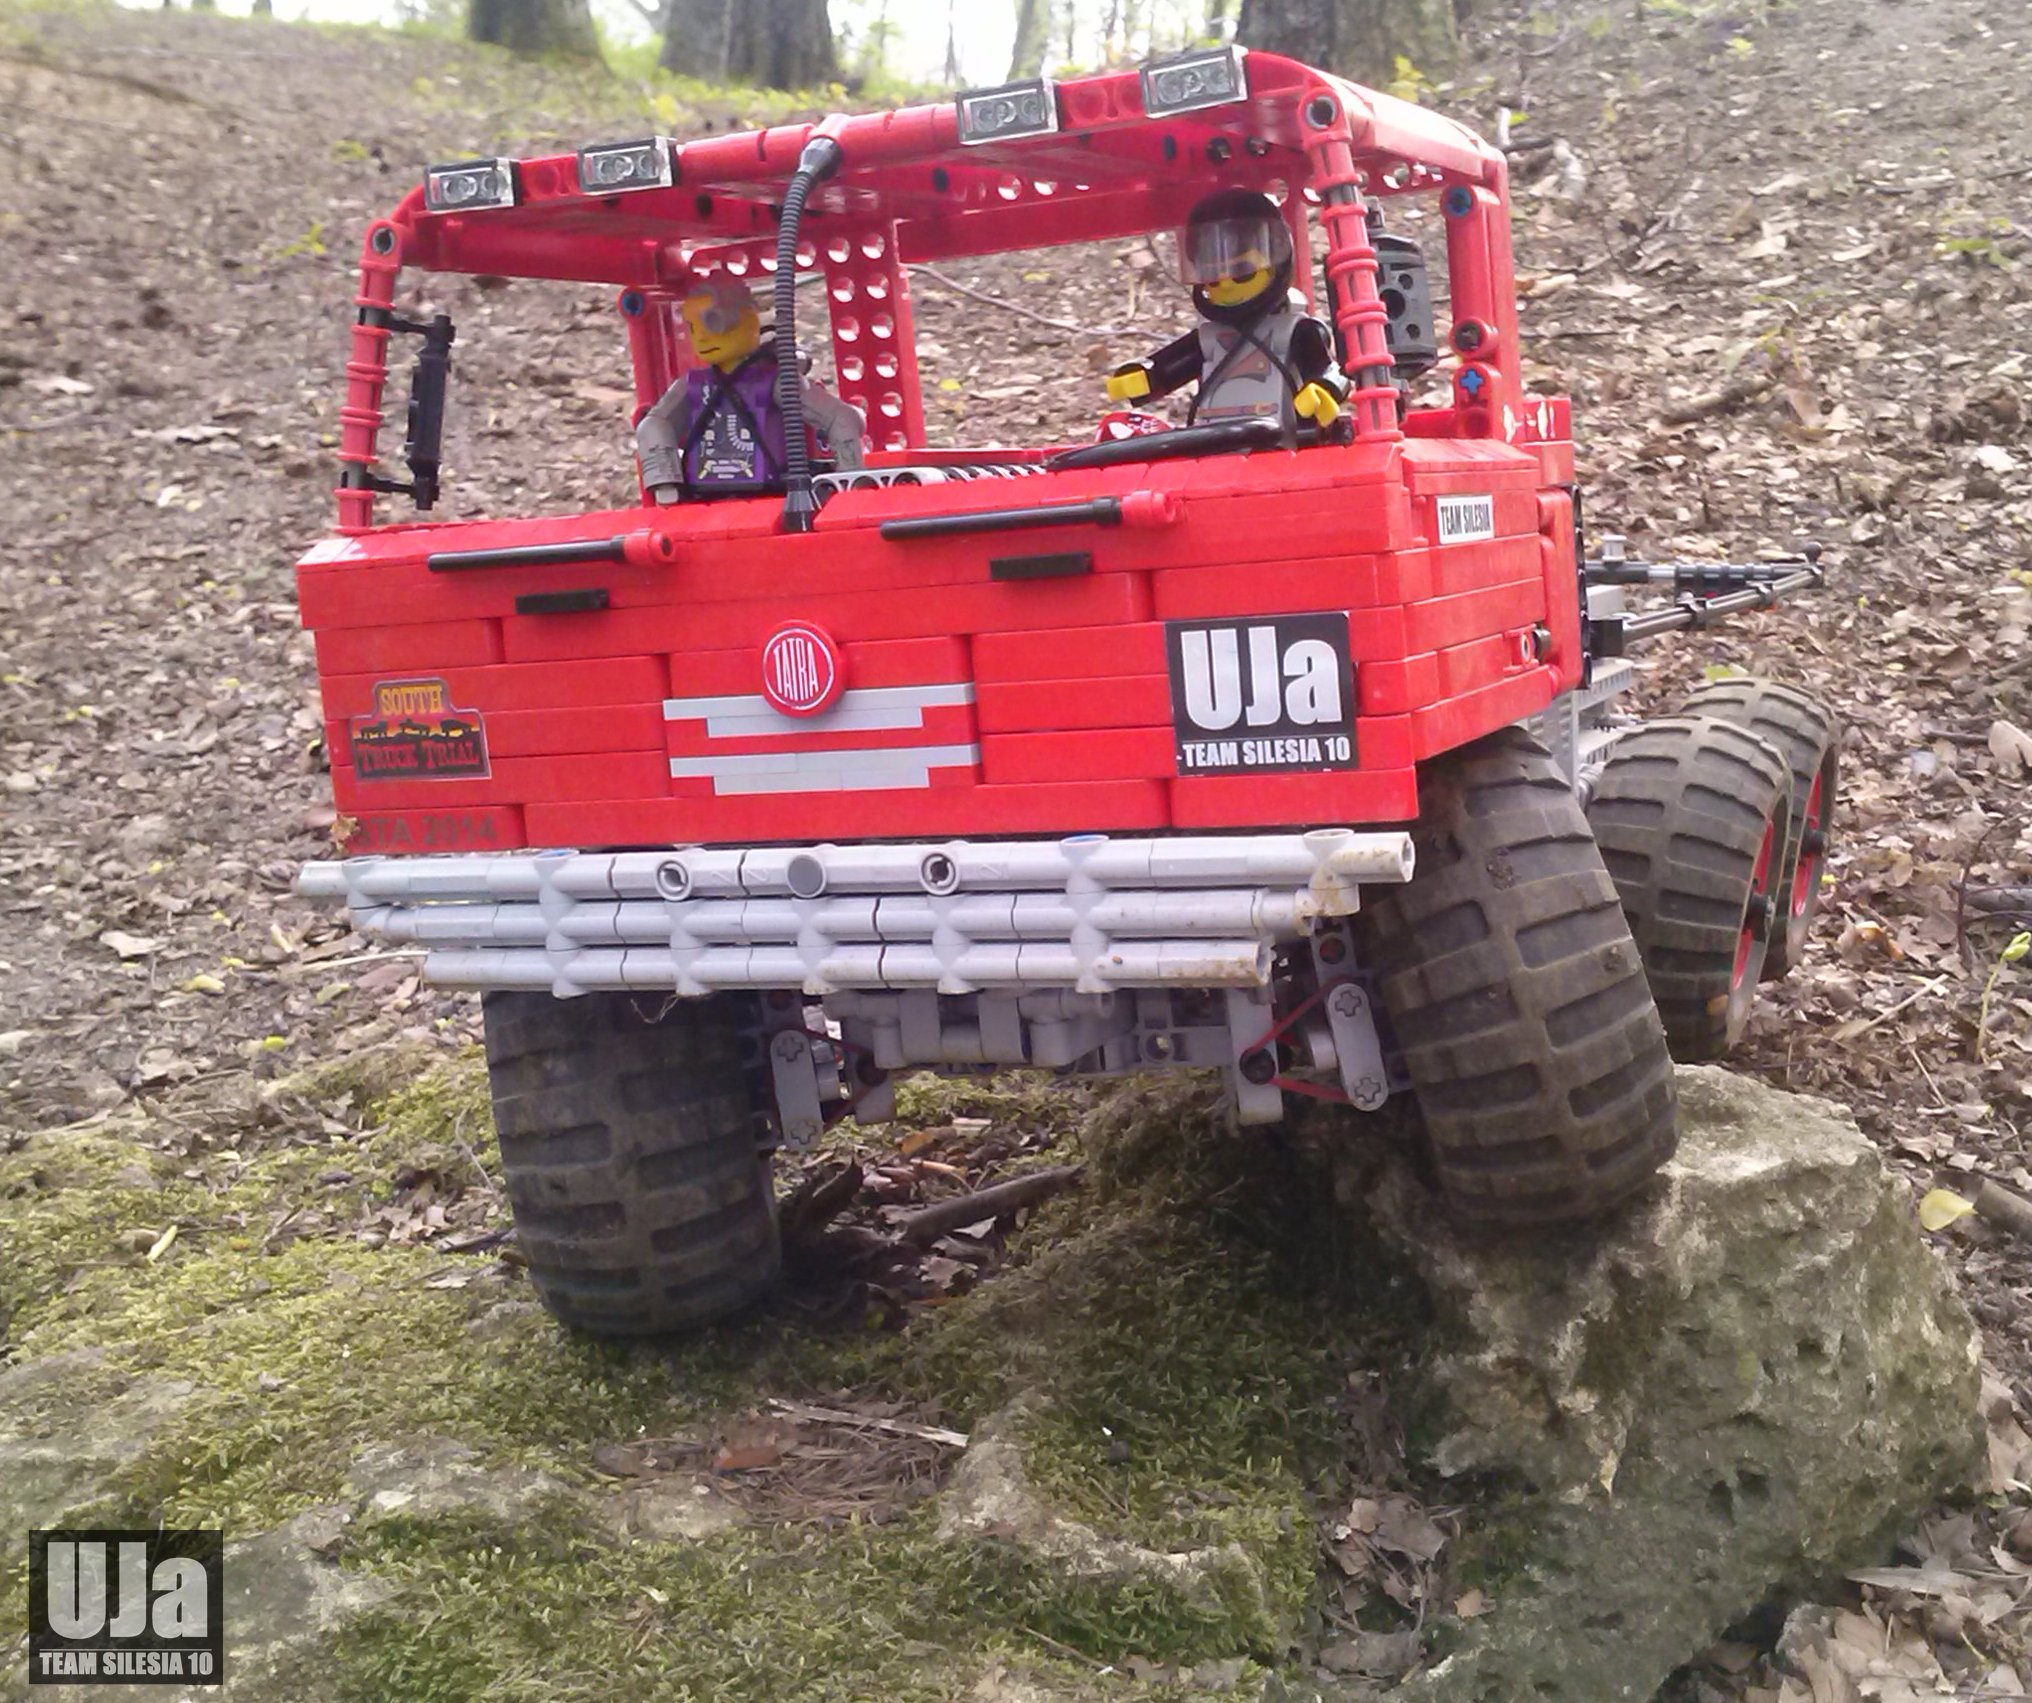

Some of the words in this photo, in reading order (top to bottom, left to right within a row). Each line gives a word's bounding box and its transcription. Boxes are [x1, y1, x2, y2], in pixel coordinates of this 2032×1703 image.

[1440, 505, 1462, 535] TEAM
[1463, 503, 1491, 533] SILESIA
[773, 638, 819, 700] TATRA
[1181, 626, 1342, 730] UJa
[380, 685, 443, 717] SOUTH
[355, 744, 418, 772] TRUCK
[421, 739, 479, 769] TRIAL
[1182, 742, 1238, 767] TEAM
[1242, 739, 1322, 764] SILESIA
[1325, 737, 1351, 761] 10
[421, 815, 497, 845] 2014
